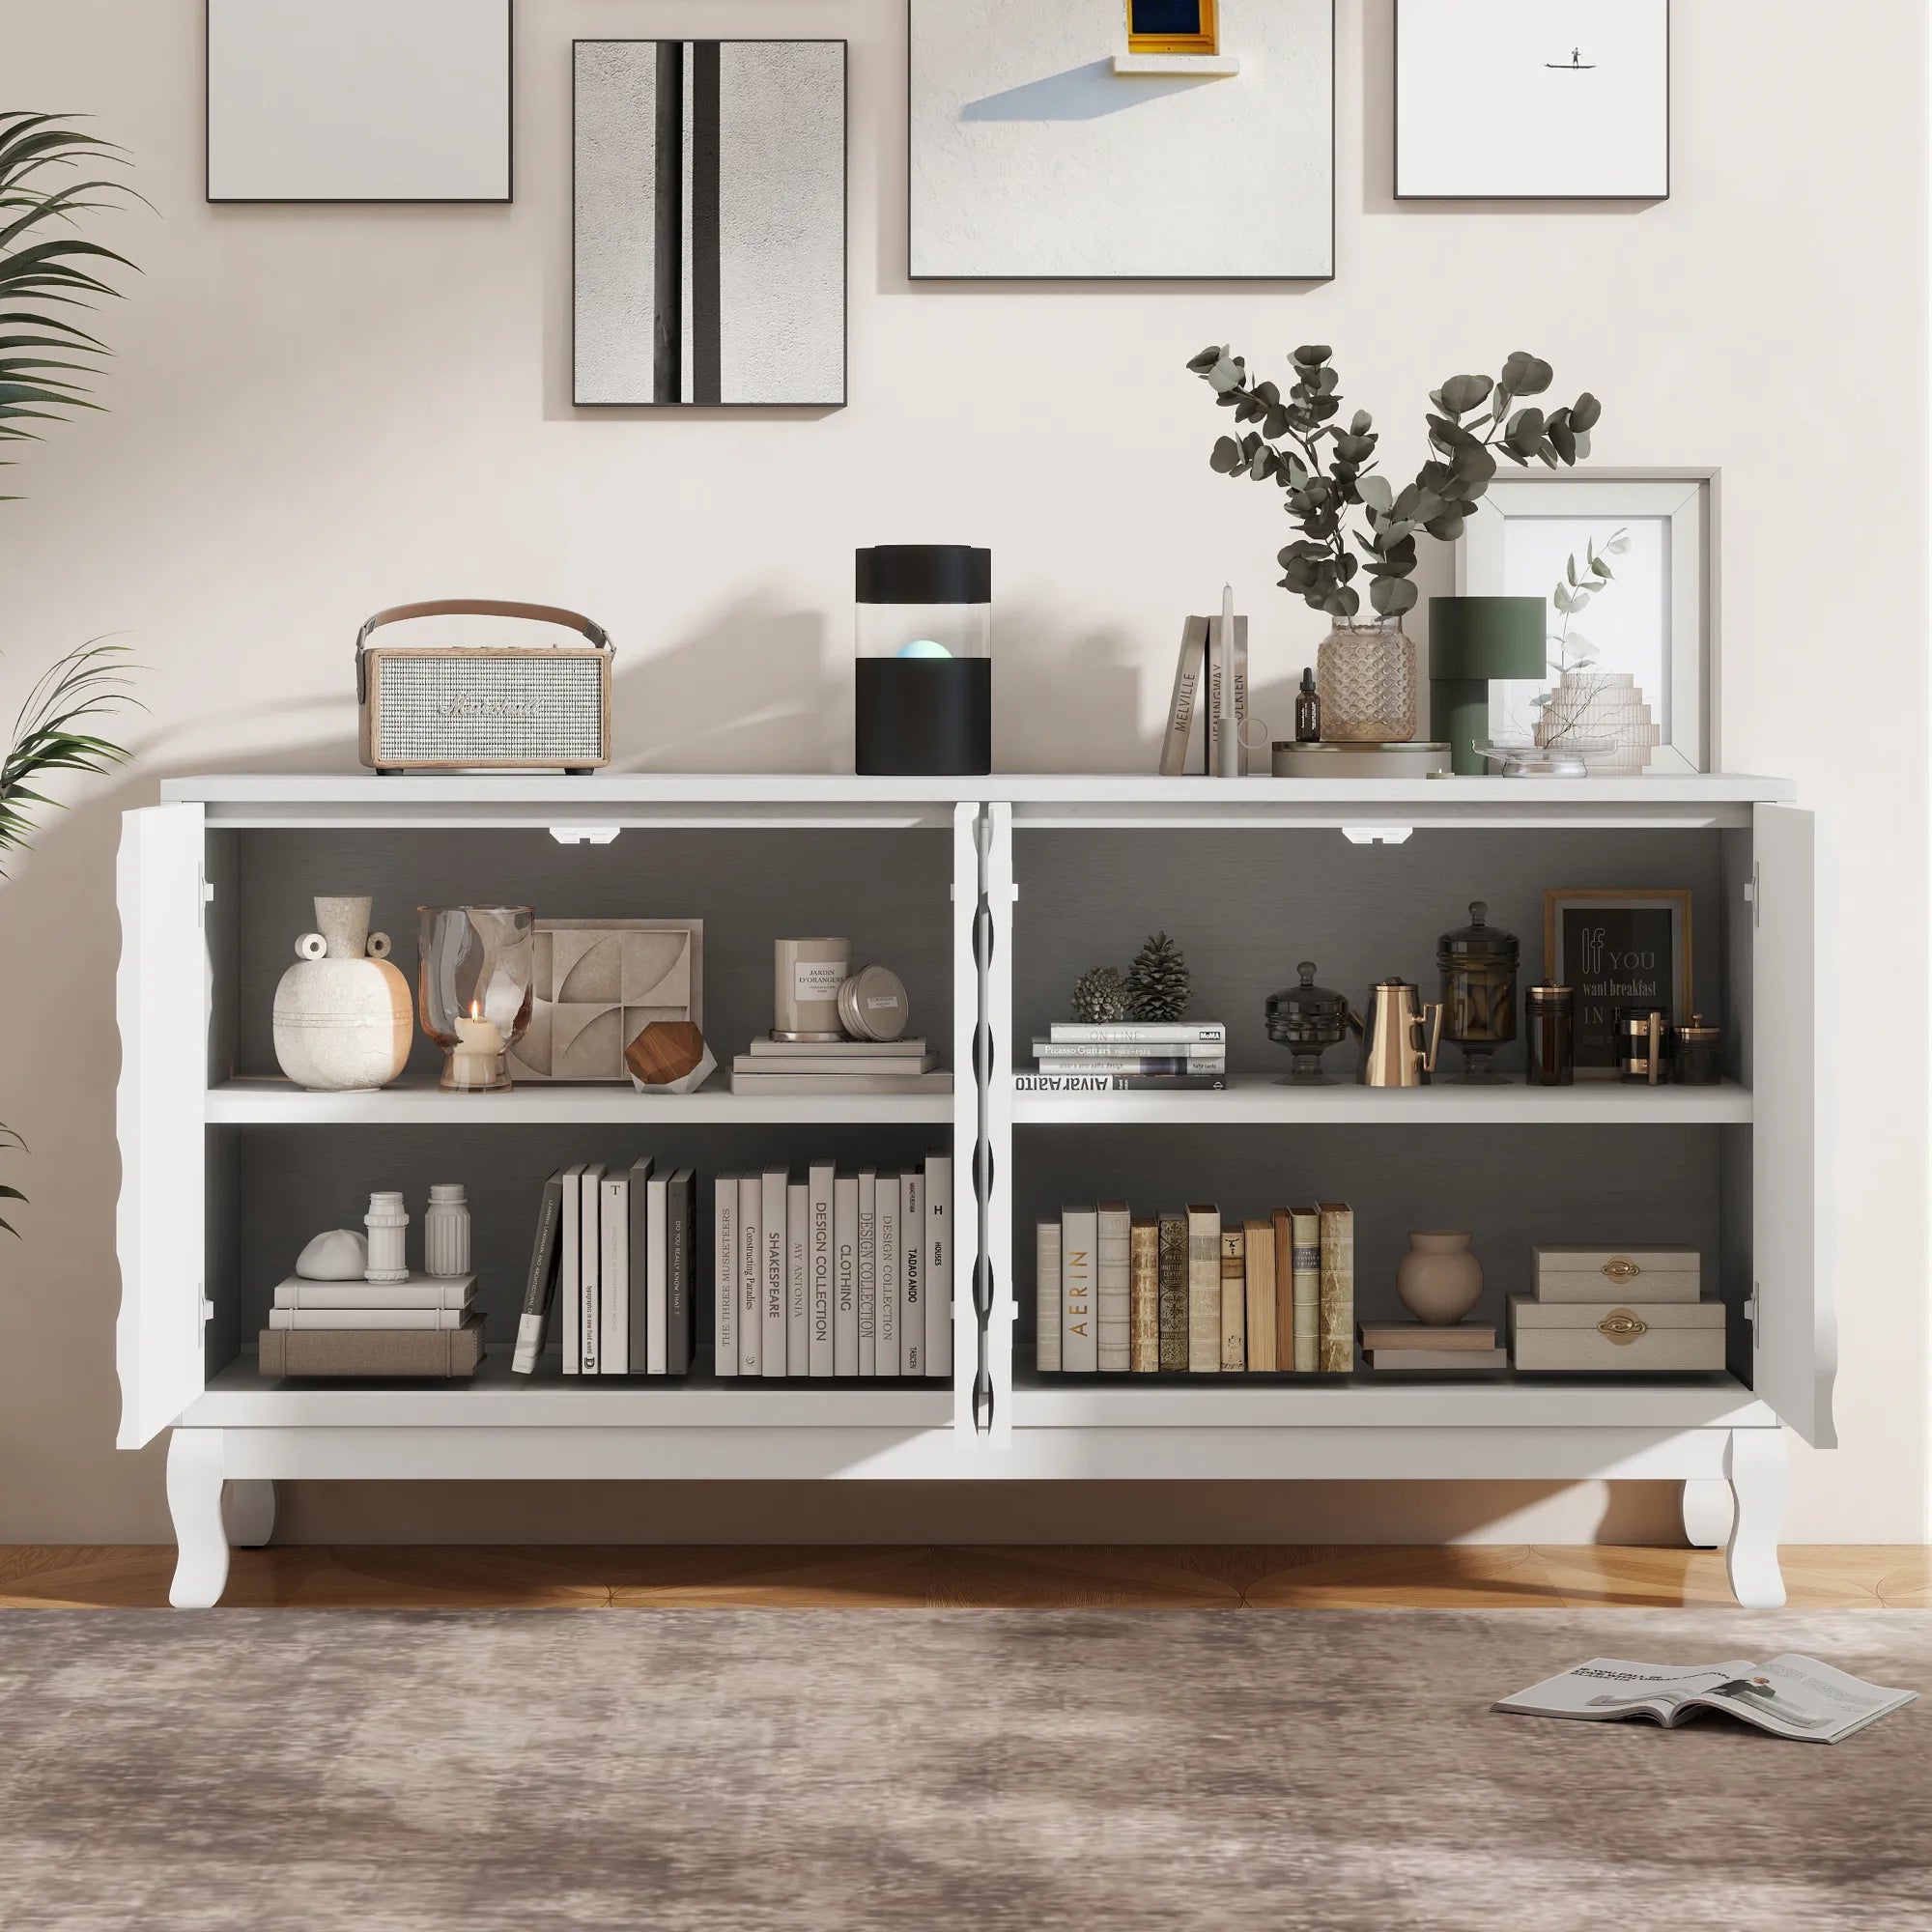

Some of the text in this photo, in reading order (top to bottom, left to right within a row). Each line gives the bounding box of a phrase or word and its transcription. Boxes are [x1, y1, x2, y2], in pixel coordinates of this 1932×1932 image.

[439, 692, 545, 717] Marshall
[1175, 672, 1195, 732] MELVILLE
[1582, 928, 1655, 974] If YOU
[1582, 978, 1656, 997] want breakfast
[1583, 1006, 1604, 1024] IN
[1044, 1045, 1076, 1055] Picasso
[1077, 1045, 1111, 1055] Guitars
[1090, 1031, 1107, 1041] ON
[1113, 1031, 1141, 1041] LINE
[611, 1185, 621, 1196] T
[722, 1208, 730, 1282] MUSKETEERS
[744, 1226, 755, 1311] Constructing Paradies
[769, 1233, 780, 1319] SHAKESPEARE
[815, 1202, 827, 1341] DESIGN COLLECTION
[860, 1212, 873, 1338] DESIGN COLLECTION
[908, 1248, 917, 1303] TADAO ANDO
[794, 1242, 803, 1318] MY ANTONIA
[840, 1244, 852, 1311] CLOTHING
[883, 1215, 892, 1341] DESIGN COLLECTION
[1068, 1251, 1088, 1337] AERIN
